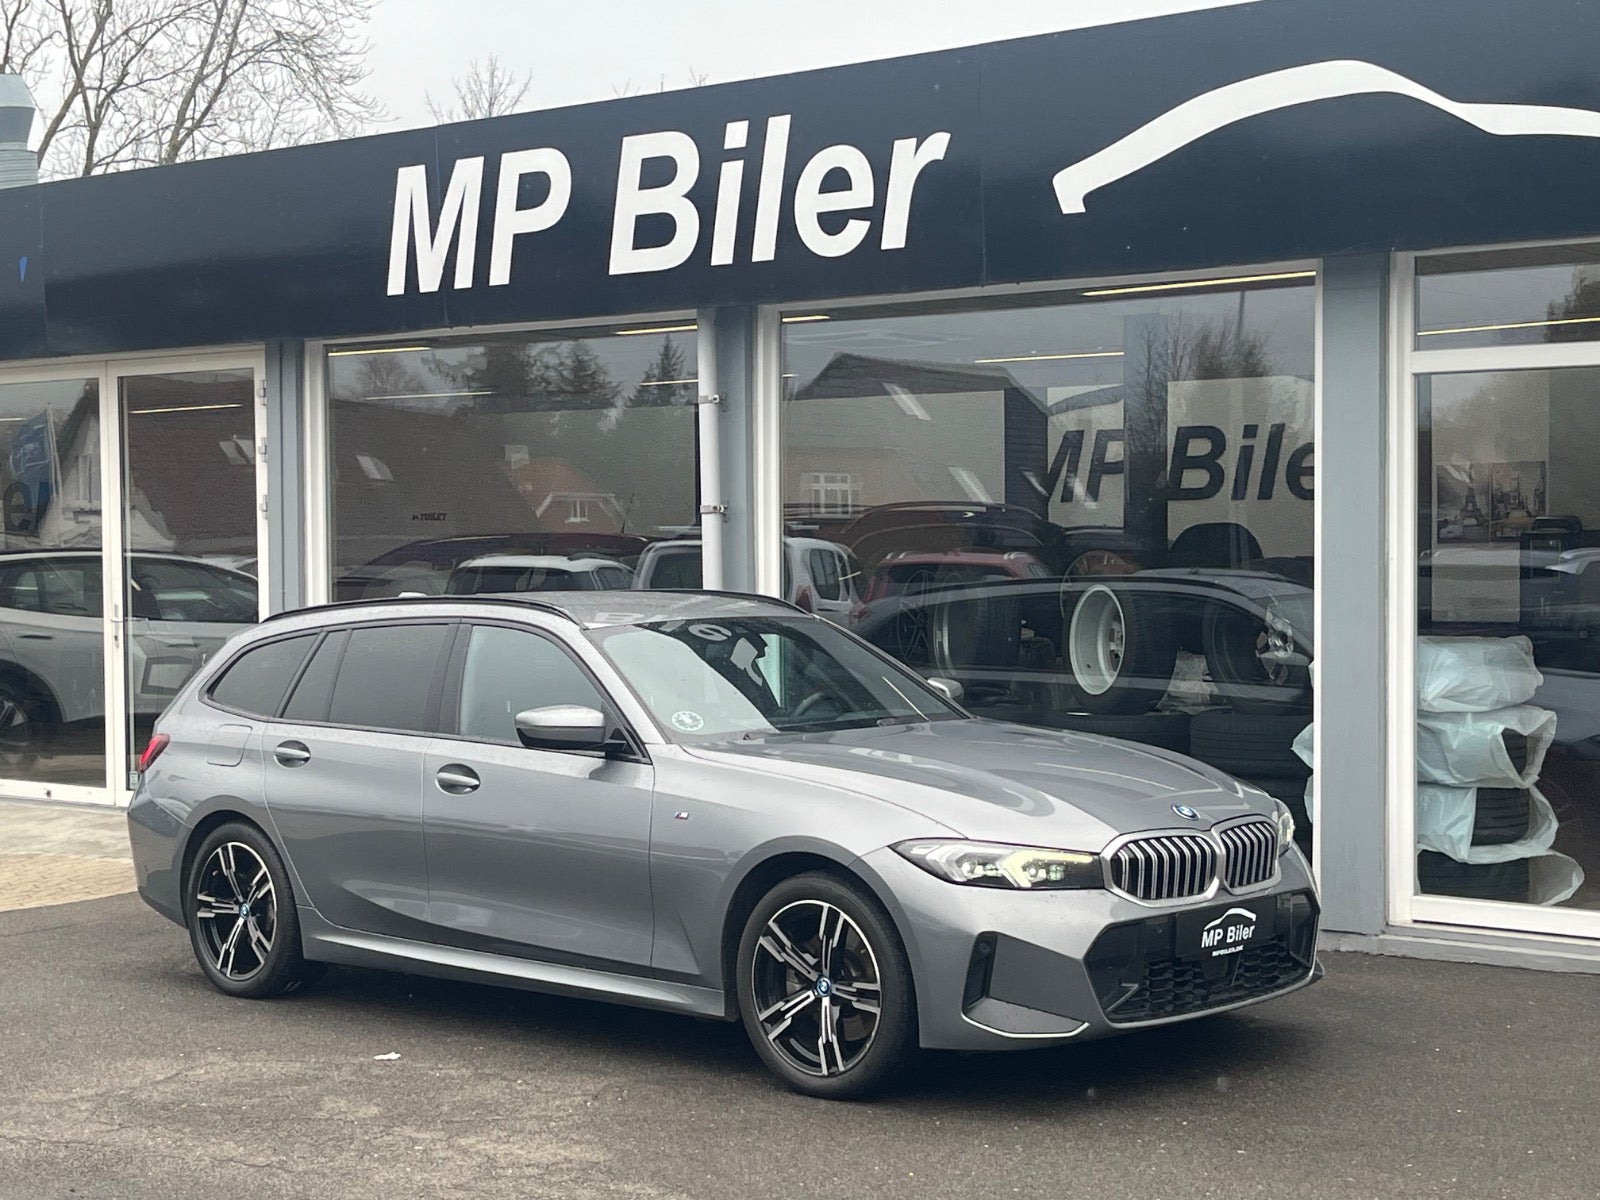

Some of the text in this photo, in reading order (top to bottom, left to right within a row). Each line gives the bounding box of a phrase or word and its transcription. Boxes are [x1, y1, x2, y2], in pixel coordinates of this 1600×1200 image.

[387, 114, 951, 297] MP Biler
[1202, 924, 1256, 948] MP Biler
